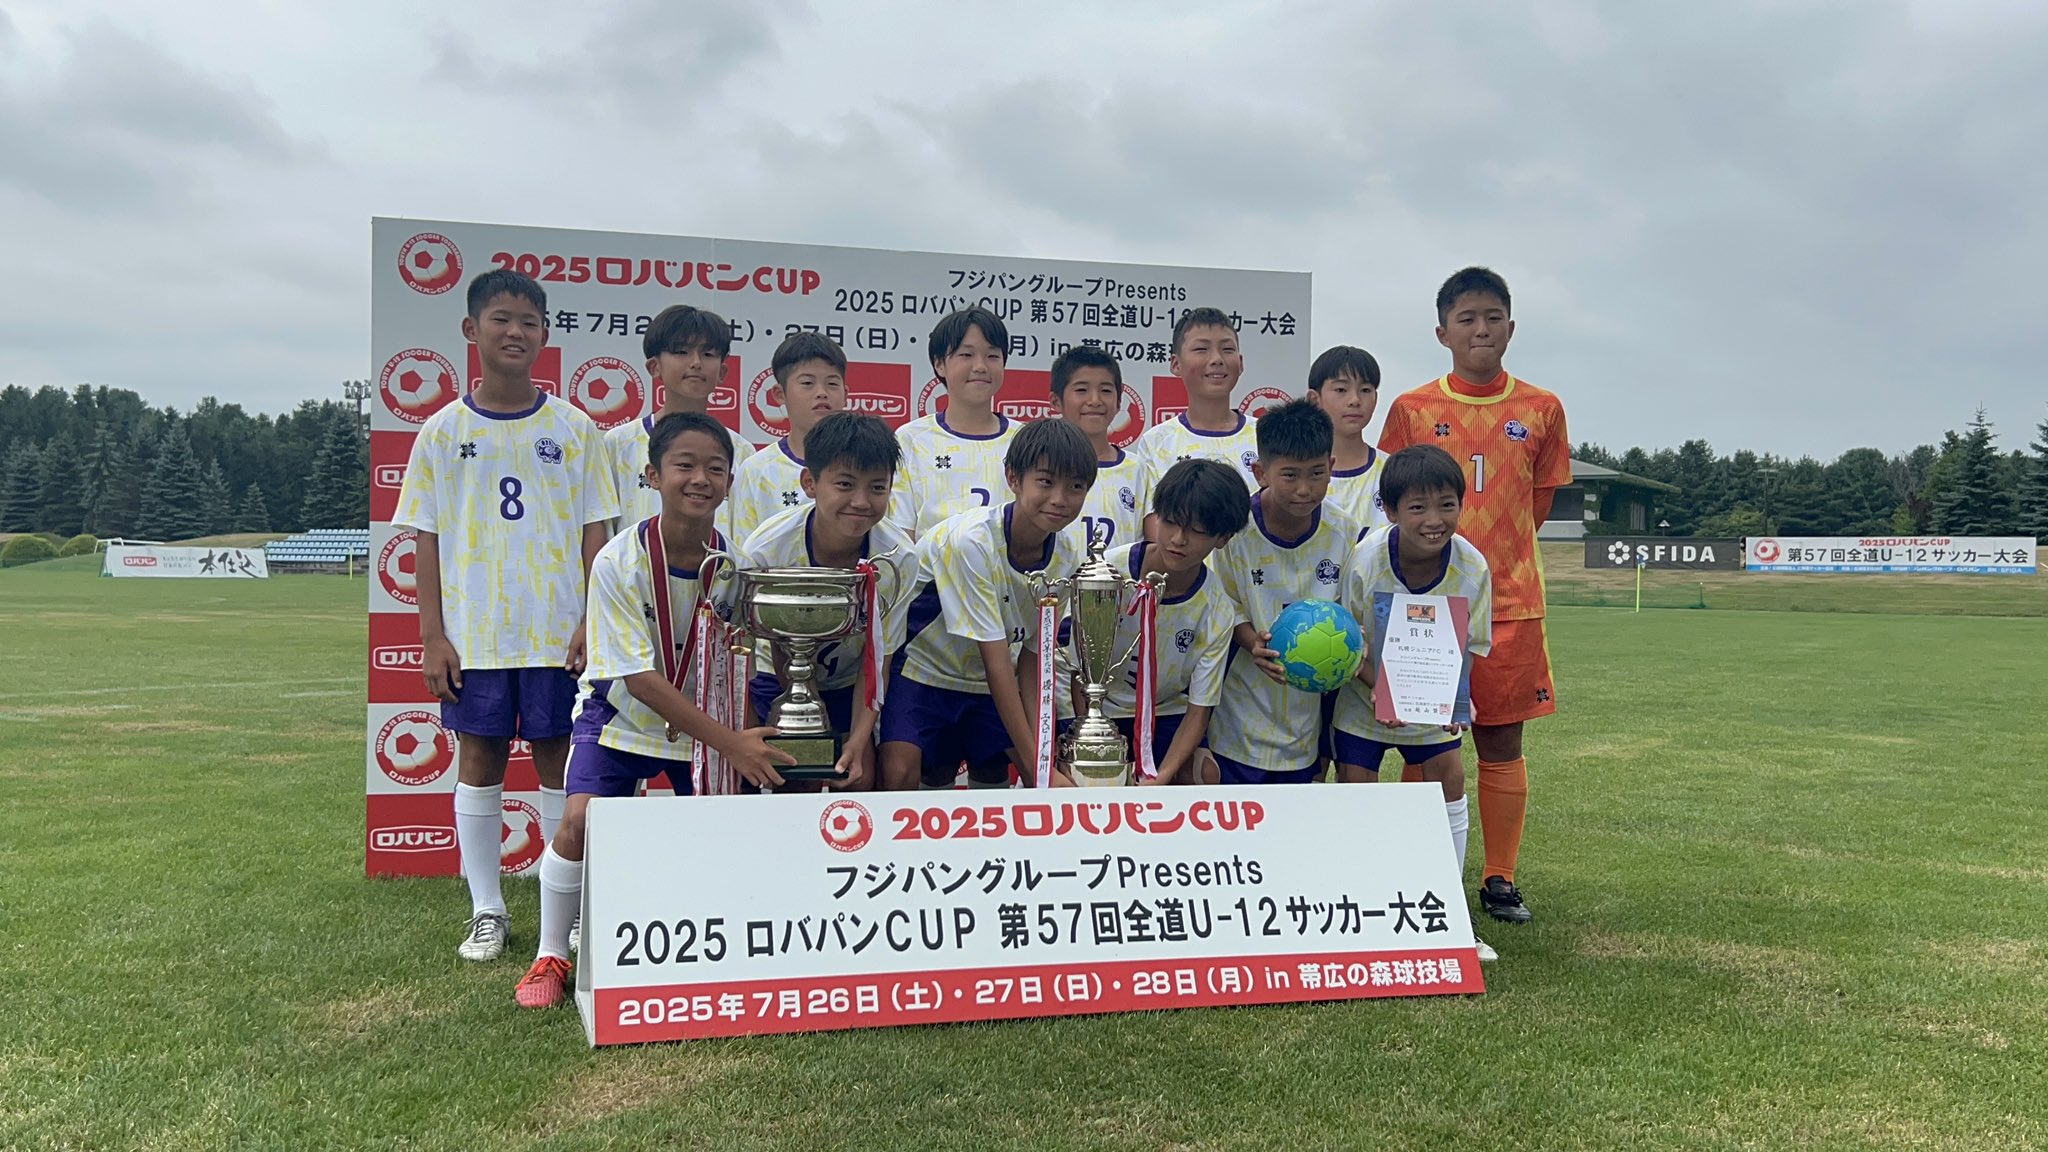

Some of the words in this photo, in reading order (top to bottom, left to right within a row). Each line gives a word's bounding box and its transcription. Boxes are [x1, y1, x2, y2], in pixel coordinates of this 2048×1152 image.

[491, 252, 821, 295] 2025ロバパンCUP
[949, 270, 1187, 301] フジパングループPresents
[835, 288, 894, 314] 2025
[1469, 453, 1484, 494] 1
[500, 476, 524, 521] 8
[1636, 544, 1716, 563] SFIDA
[1787, 547, 2029, 564] 第57回全道U-12サッカー大会
[388, 769, 441, 785] ロバパンCUP
[891, 800, 1265, 840] 2025ロバパンCUP
[377, 832, 452, 847] ロバパン
[826, 854, 1264, 899] フジパングループPresents
[616, 917, 727, 966] 2025
[747, 907, 976, 957] ロバパンCUP
[997, 889, 1449, 950] 第57回全道U-12サッカー大会
[1265, 965, 1290, 989] in
[1298, 957, 1463, 989] 帯広の森球技場
